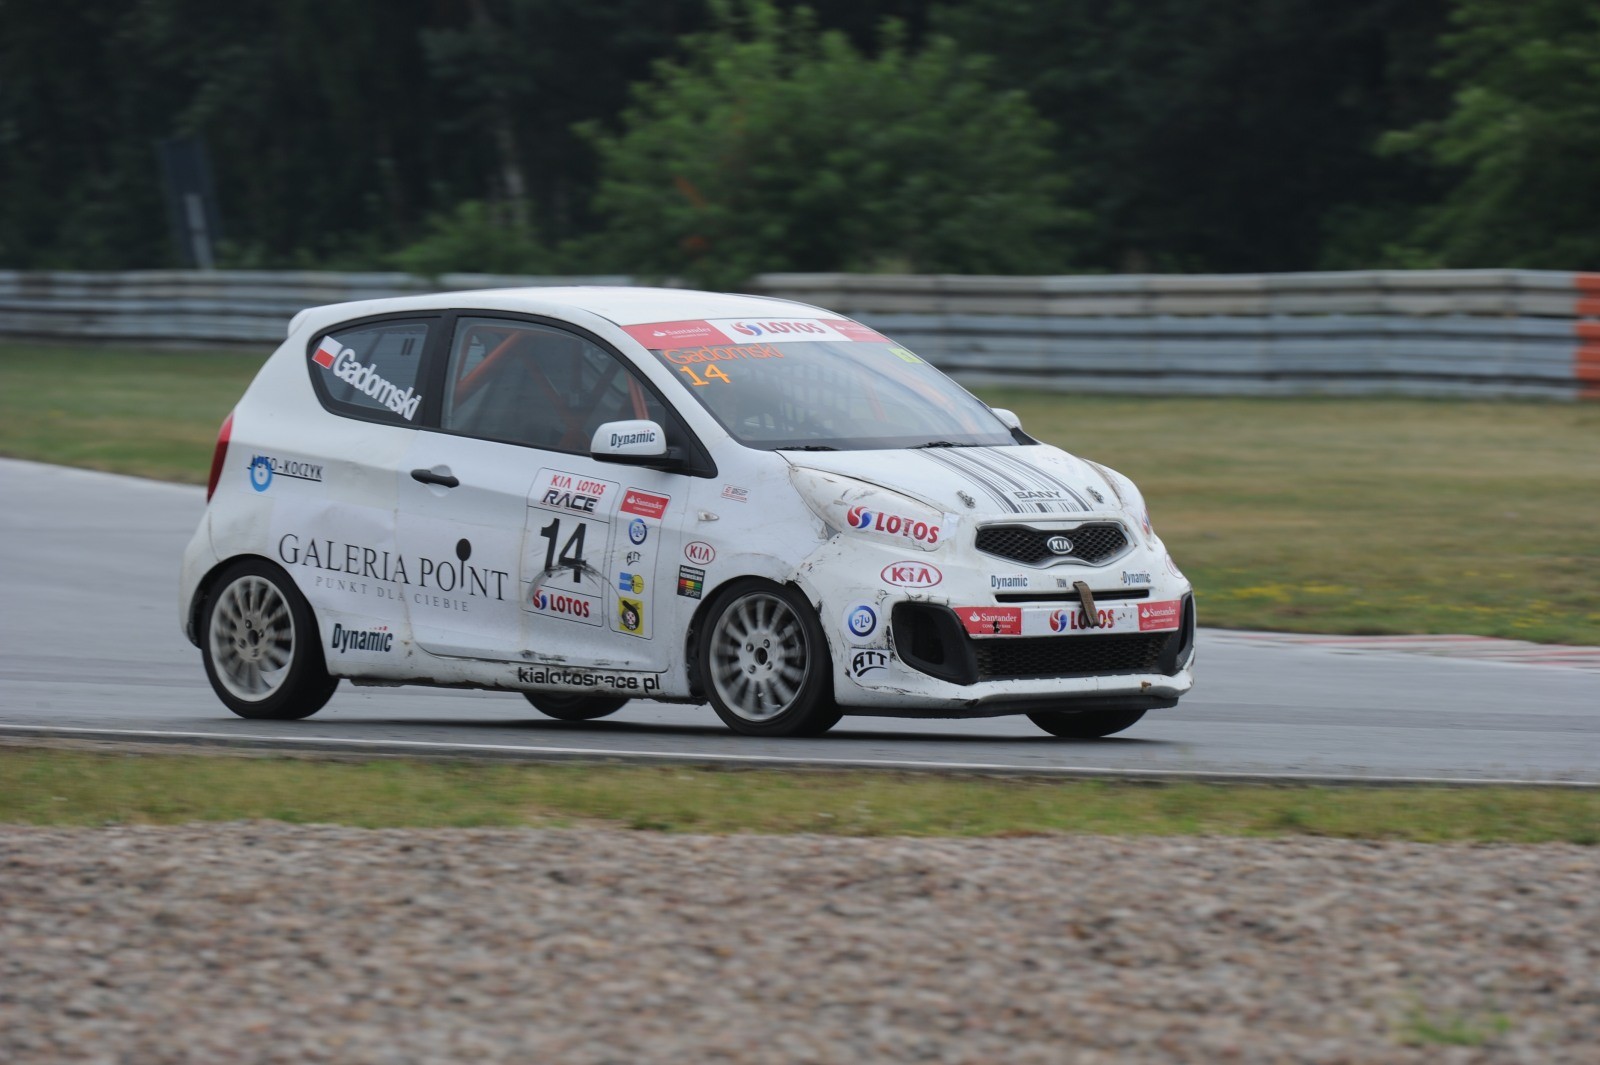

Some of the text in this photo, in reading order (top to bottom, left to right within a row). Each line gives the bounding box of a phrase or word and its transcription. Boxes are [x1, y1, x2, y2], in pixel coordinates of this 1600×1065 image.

[757, 321, 826, 334] LOTOS
[663, 343, 785, 365] Gadomski
[333, 348, 422, 421] Gadomski
[680, 364, 731, 386] 14
[610, 429, 656, 448] Dynamic
[551, 474, 606, 496] KIA LOTOS
[1013, 491, 1061, 499] BANY
[542, 489, 598, 513] RACE
[875, 511, 940, 544] LOTOS
[540, 517, 587, 583] 14
[689, 545, 710, 561] KIA
[1051, 540, 1071, 550] KIA
[278, 533, 509, 601] GALERIA POINT
[892, 567, 932, 584] KIA
[991, 574, 1028, 590] Dynamic
[1122, 571, 1151, 586] Dynamic
[315, 576, 368, 595] PUNKT
[414, 593, 469, 612] CIEBIE
[550, 593, 590, 618] LOTOS
[854, 614, 871, 628] PZU
[981, 612, 1017, 622] Santander
[1070, 609, 1115, 631] LOOS
[331, 622, 393, 654] Dynamic
